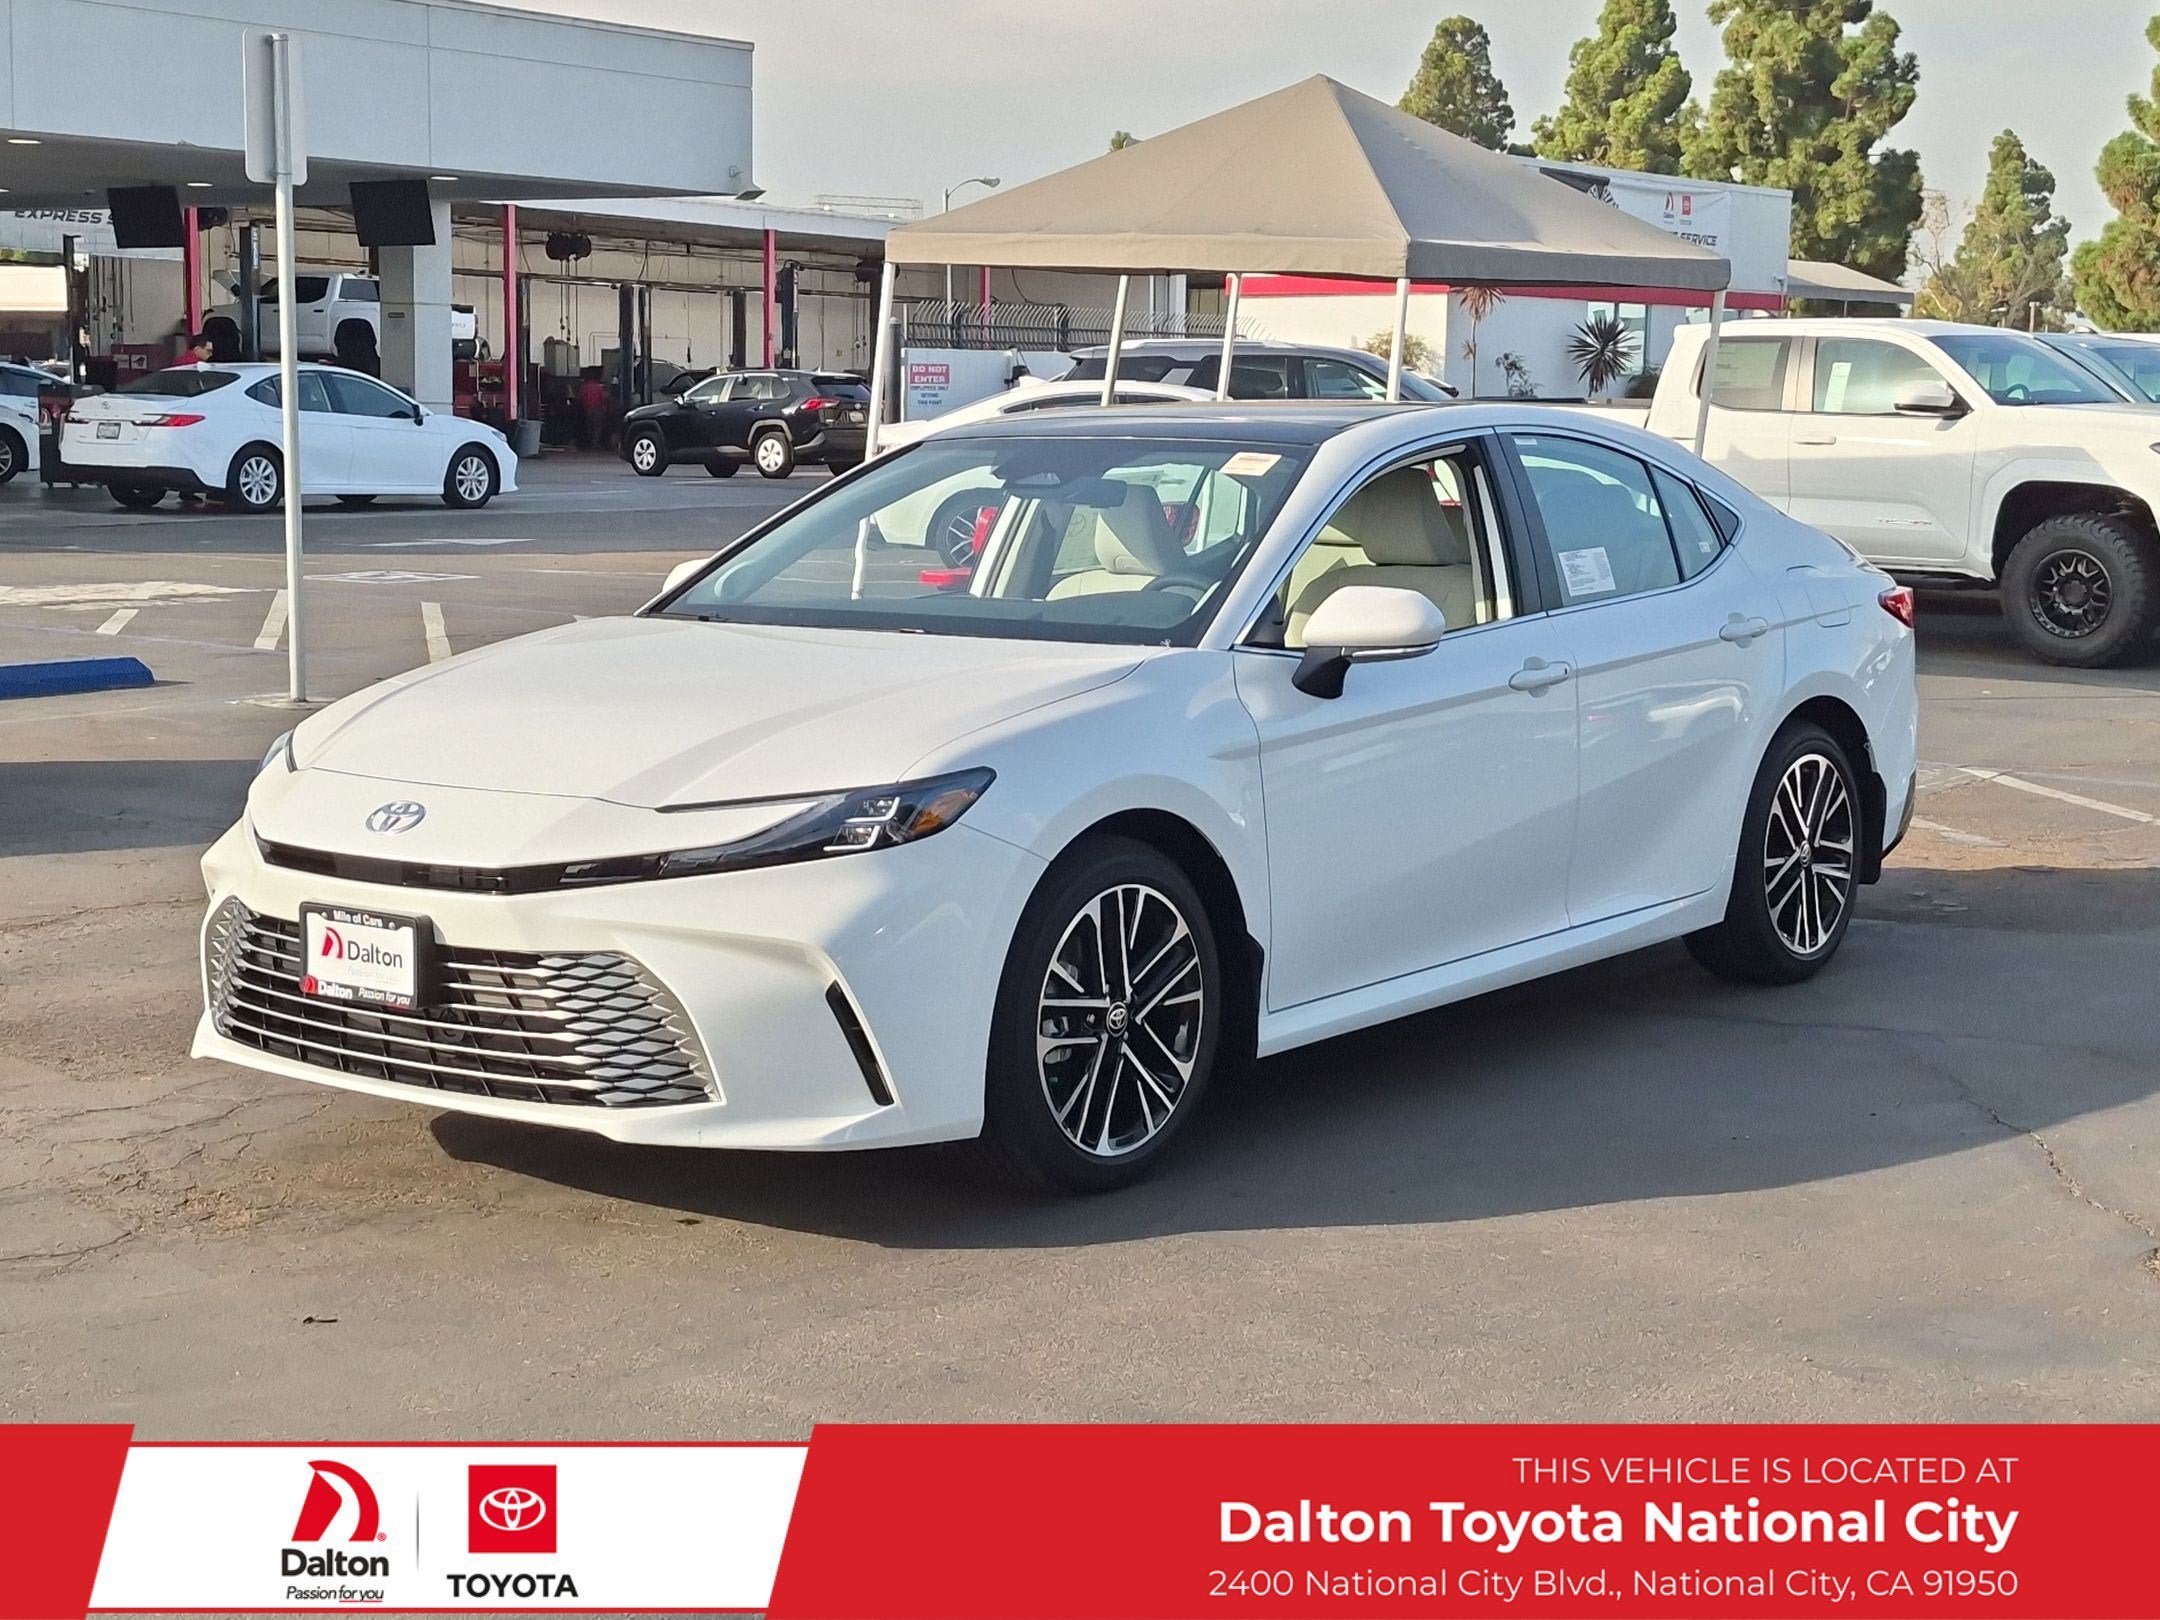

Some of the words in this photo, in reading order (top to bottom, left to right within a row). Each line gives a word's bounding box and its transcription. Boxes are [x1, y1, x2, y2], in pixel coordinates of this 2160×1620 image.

[15, 208, 103, 225] EXPRESS
[912, 365, 926, 373] DO
[928, 365, 948, 373] NOT
[914, 375, 946, 383] ENTER
[333, 909, 351, 922] Mile
[352, 913, 362, 924] of
[363, 914, 383, 928] Cars
[347, 940, 403, 969] Dalton
[318, 980, 353, 1000] Dalton
[358, 987, 385, 1002] Passion
[385, 991, 397, 1004] for
[397, 995, 411, 1006] you
